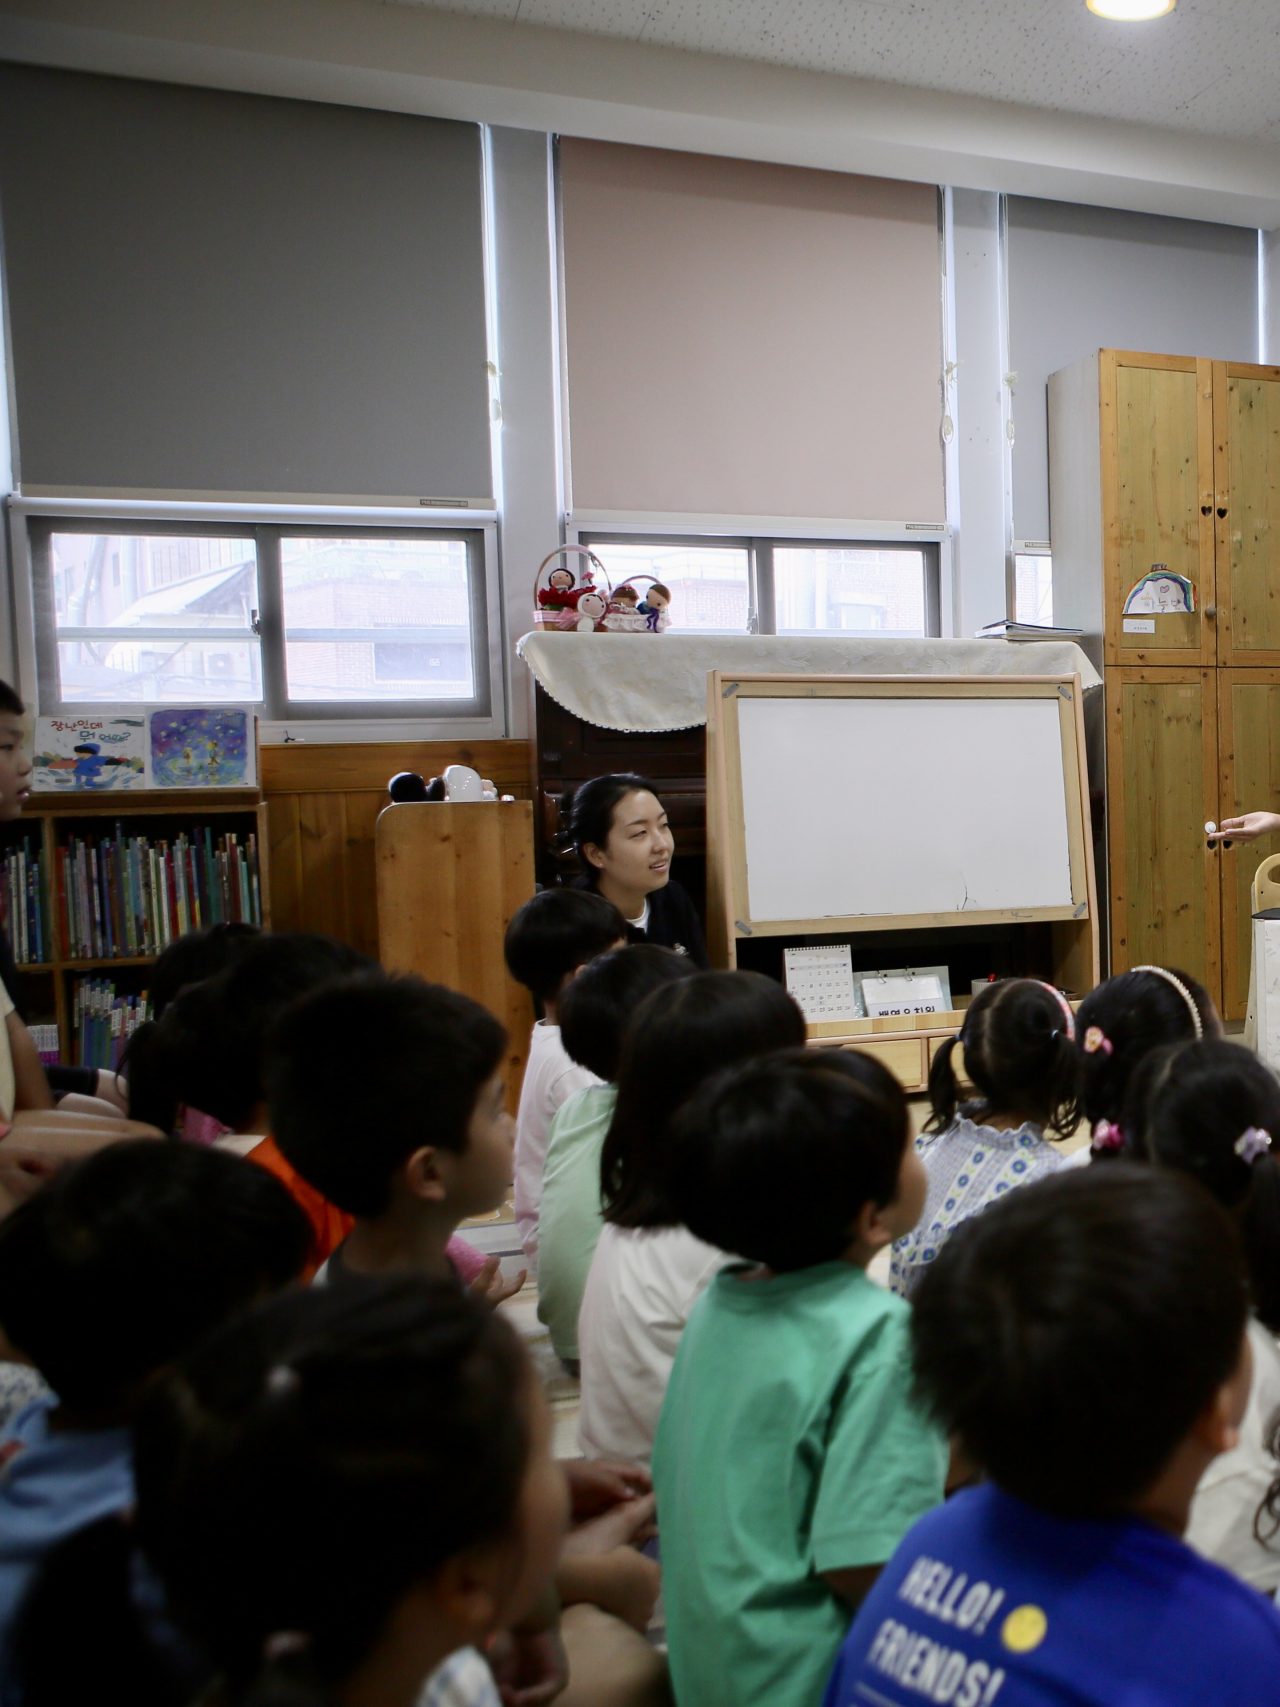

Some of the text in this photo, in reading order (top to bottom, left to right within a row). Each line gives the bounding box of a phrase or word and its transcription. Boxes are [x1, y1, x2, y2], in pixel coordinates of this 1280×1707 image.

[51, 720, 103, 731] 장난인데
[899, 1555, 1006, 1636] HELLO!
[866, 1618, 1006, 1707] FRIENDS!
